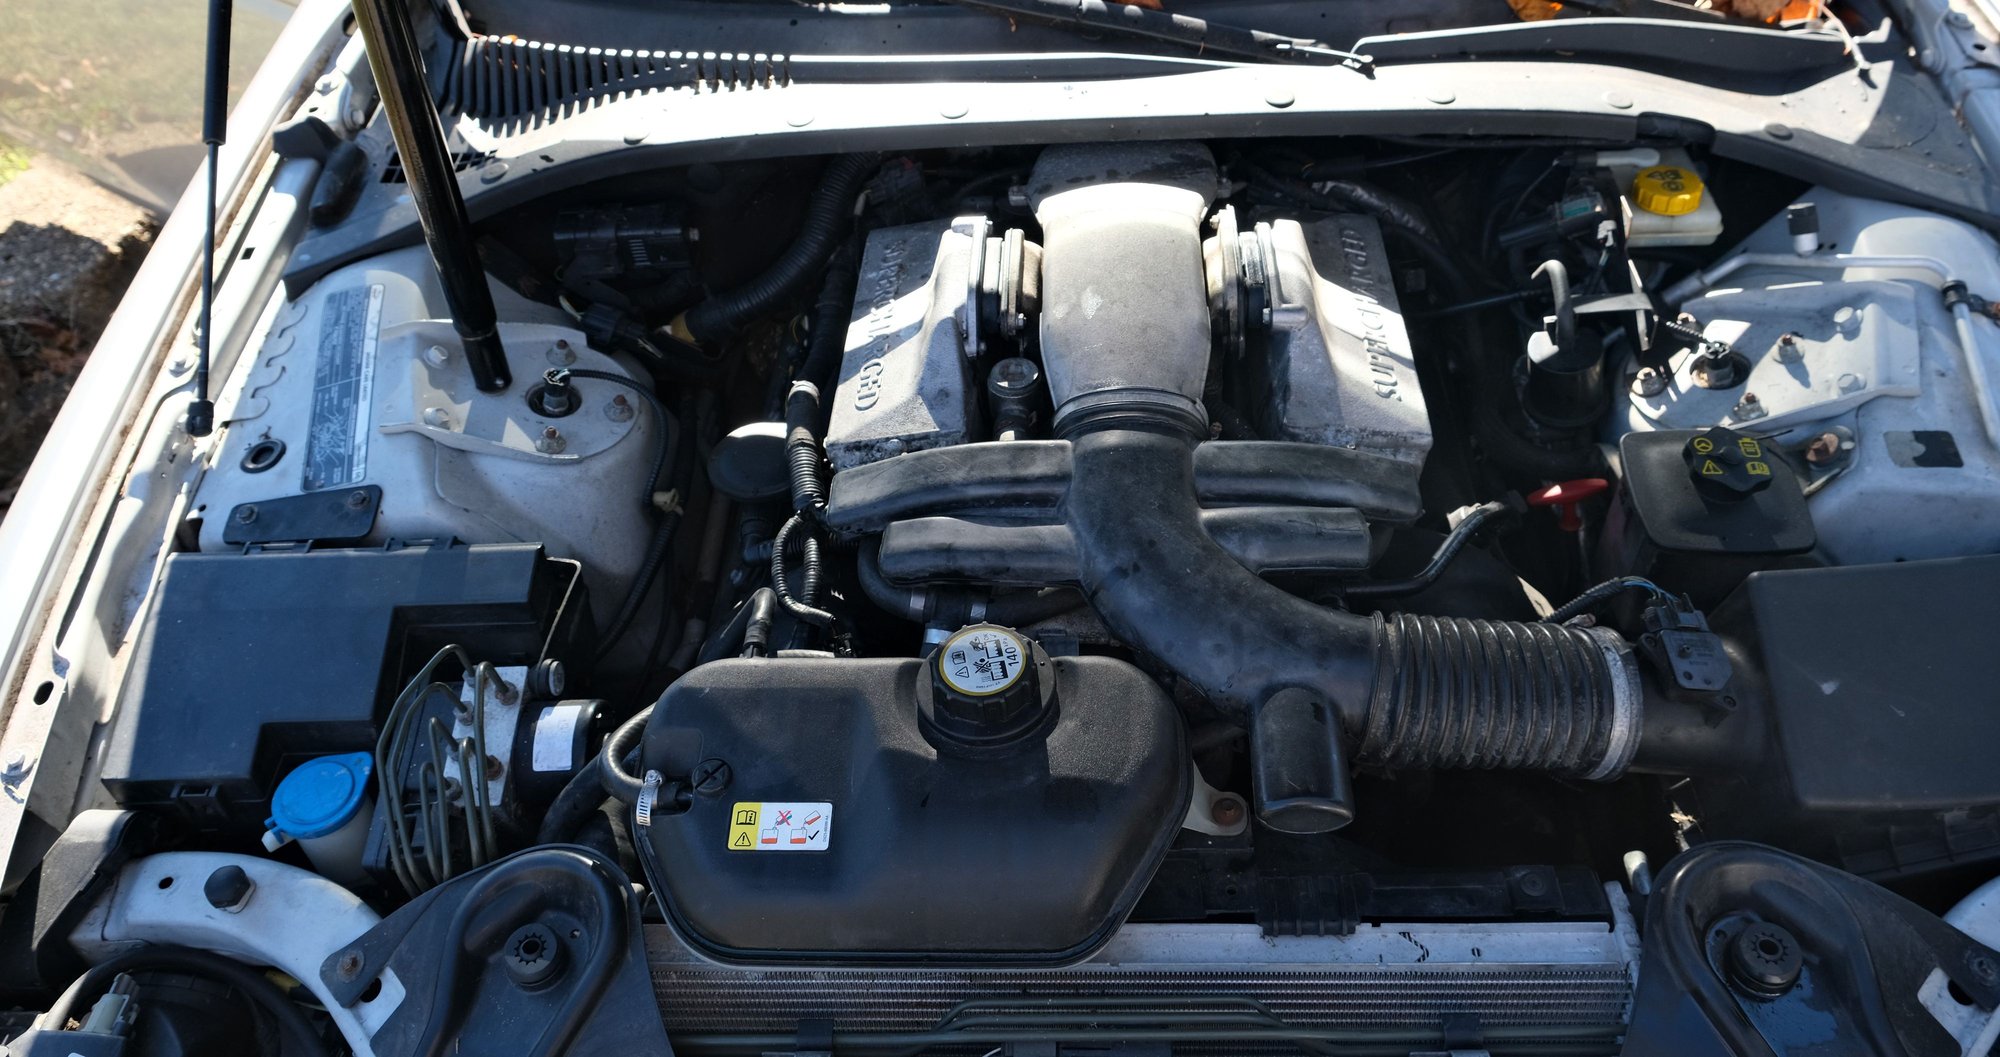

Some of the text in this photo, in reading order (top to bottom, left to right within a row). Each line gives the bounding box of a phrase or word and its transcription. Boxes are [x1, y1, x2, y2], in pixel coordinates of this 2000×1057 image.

[855, 239, 905, 412] SUPERCHARGED
[1341, 228, 1402, 402] SUPERCHARGED
[1004, 646, 1020, 667] 140
